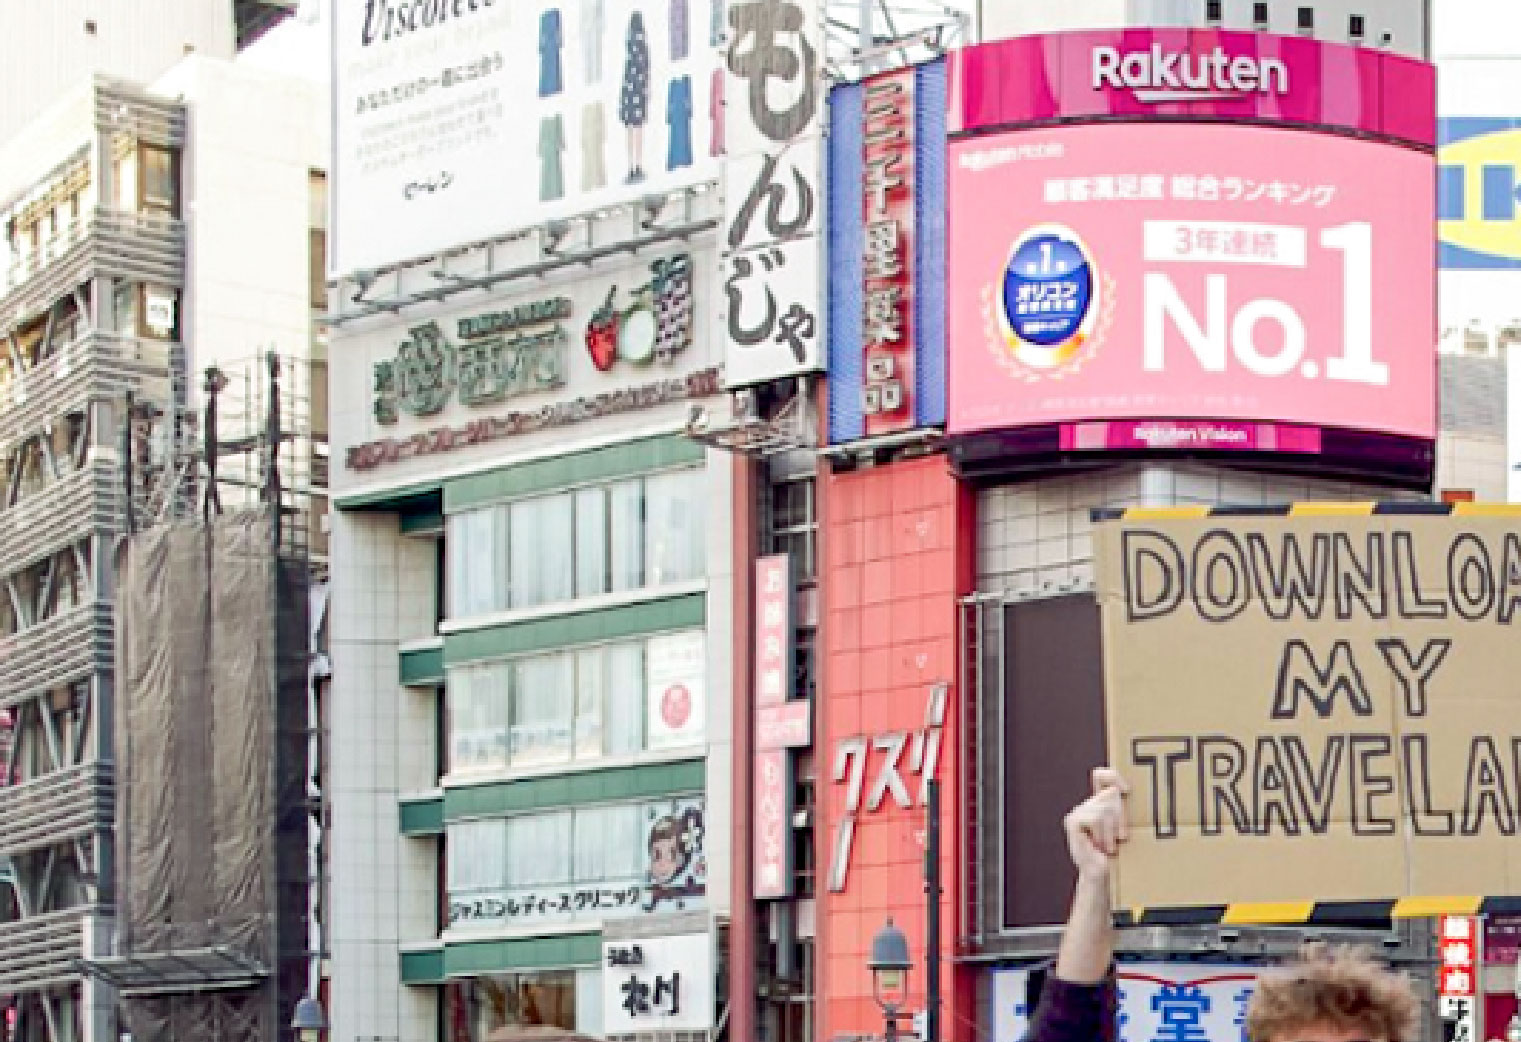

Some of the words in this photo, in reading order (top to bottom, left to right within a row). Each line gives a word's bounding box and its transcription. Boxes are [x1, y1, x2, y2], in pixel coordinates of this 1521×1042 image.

[1092, 43, 1289, 94] Rakuten
[727, 0, 816, 365] もんじゃ
[1174, 226, 1279, 259] 3年連続
[1143, 222, 1390, 385] No.1
[1270, 638, 1453, 720] MY
